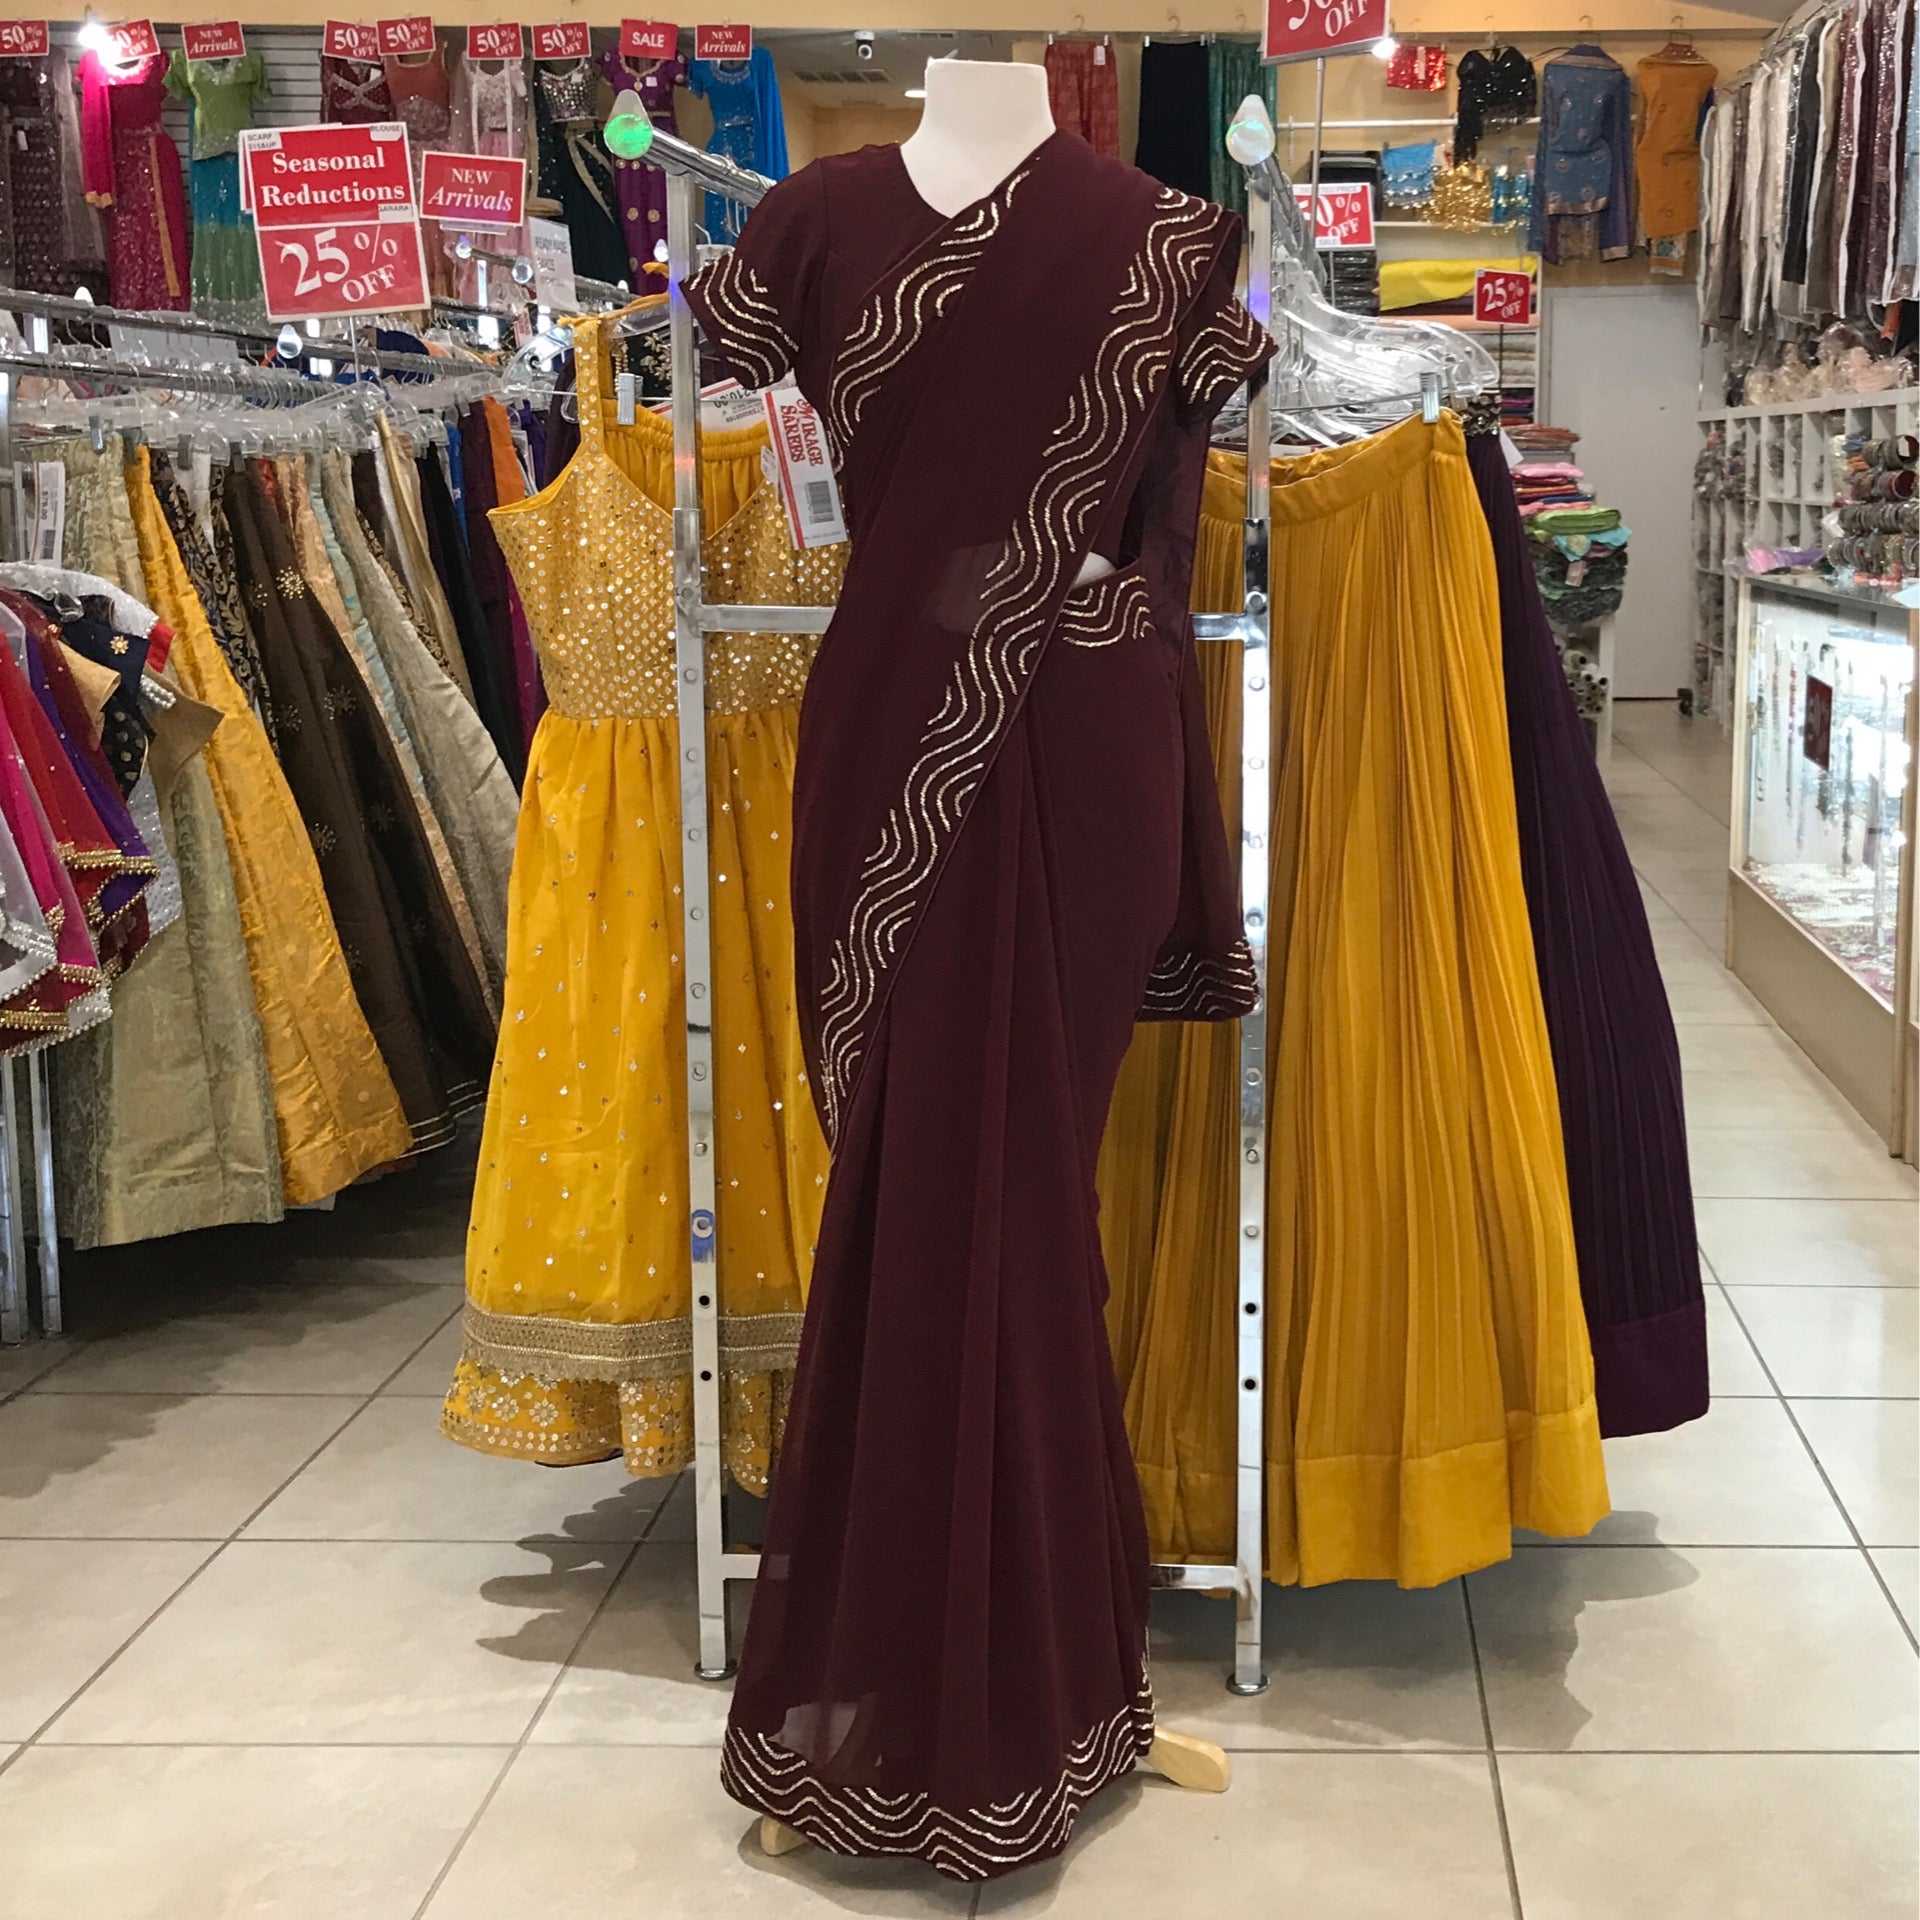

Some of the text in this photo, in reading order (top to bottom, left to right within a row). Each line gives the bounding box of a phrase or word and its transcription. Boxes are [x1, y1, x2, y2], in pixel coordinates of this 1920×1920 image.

[1, 25, 43, 49] 50%
[199, 29, 224, 39] NEW
[333, 28, 378, 50] 50%
[386, 20, 428, 47] 50%
[406, 37, 426, 50] OFF
[476, 25, 517, 52] 50%
[541, 25, 584, 53] 50%
[631, 32, 665, 48] SALE
[711, 31, 735, 40] NEW
[20, 40, 42, 53] OFF
[129, 41, 149, 56] OFF
[190, 37, 239, 54] Arrivals
[353, 46, 375, 58] OFF
[495, 42, 516, 56] OFF
[562, 41, 583, 55] OFF
[700, 40, 747, 54] Arrivals
[272, 147, 386, 174] Seasonal
[451, 168, 493, 185] NEW
[260, 182, 405, 207] Reductions
[427, 186, 514, 212] Arrivals
[1327, 218, 1359, 240] OFF
[275, 225, 399, 297] 25%
[341, 264, 397, 302] OFF
[1482, 278, 1525, 312] 25%
[1501, 300, 1521, 319] OFF
[780, 404, 806, 463] SAREES
[796, 398, 824, 467] MIRAGE
